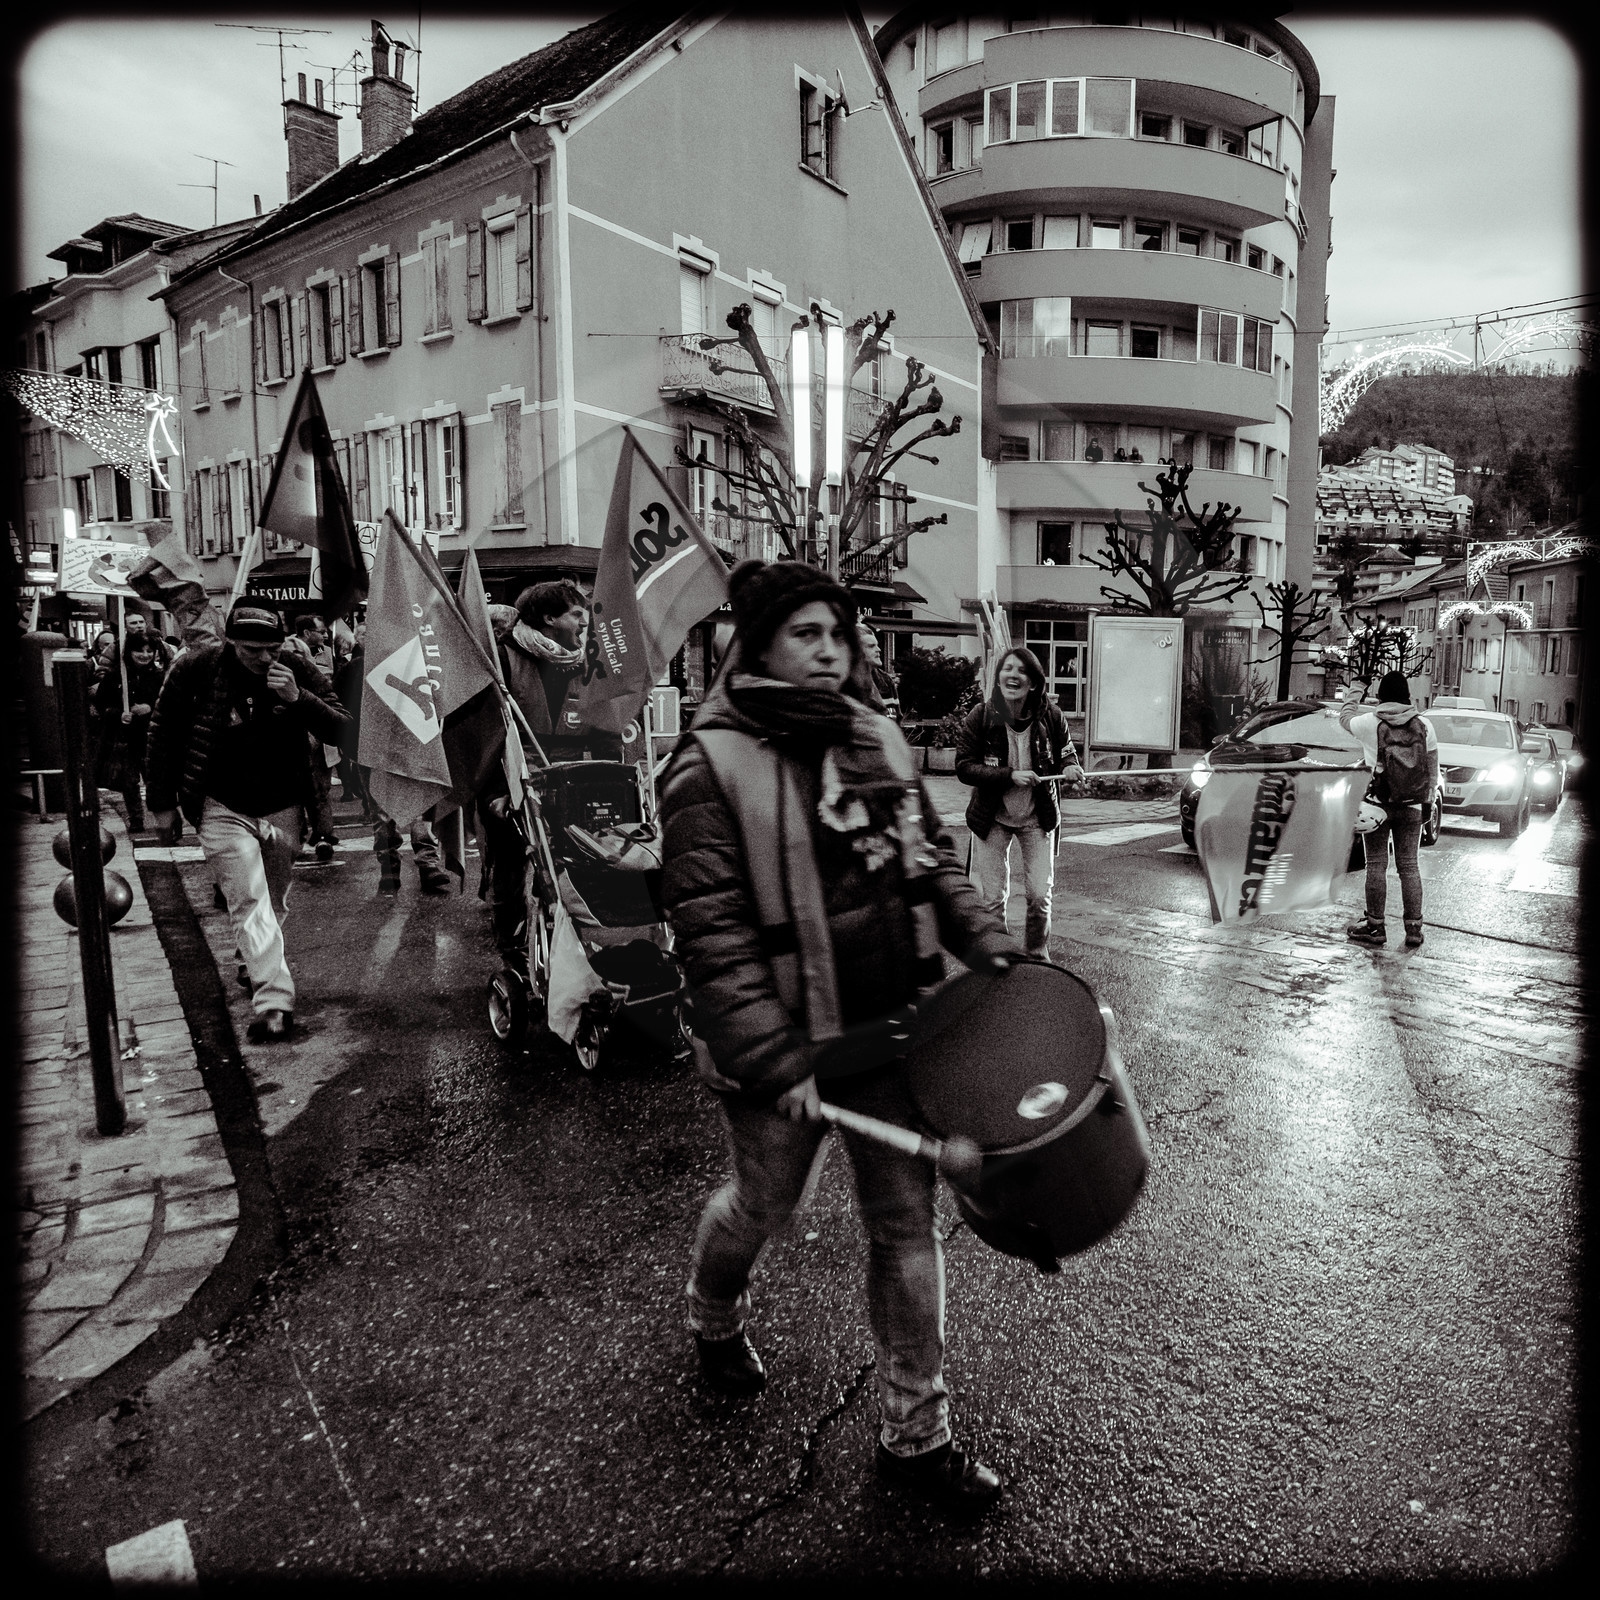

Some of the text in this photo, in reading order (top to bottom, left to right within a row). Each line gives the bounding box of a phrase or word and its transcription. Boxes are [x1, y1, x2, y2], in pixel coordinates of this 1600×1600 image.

[251, 587, 312, 601] RESTAUR
[597, 622, 623, 674] syndicale
[610, 618, 628, 653] Union
